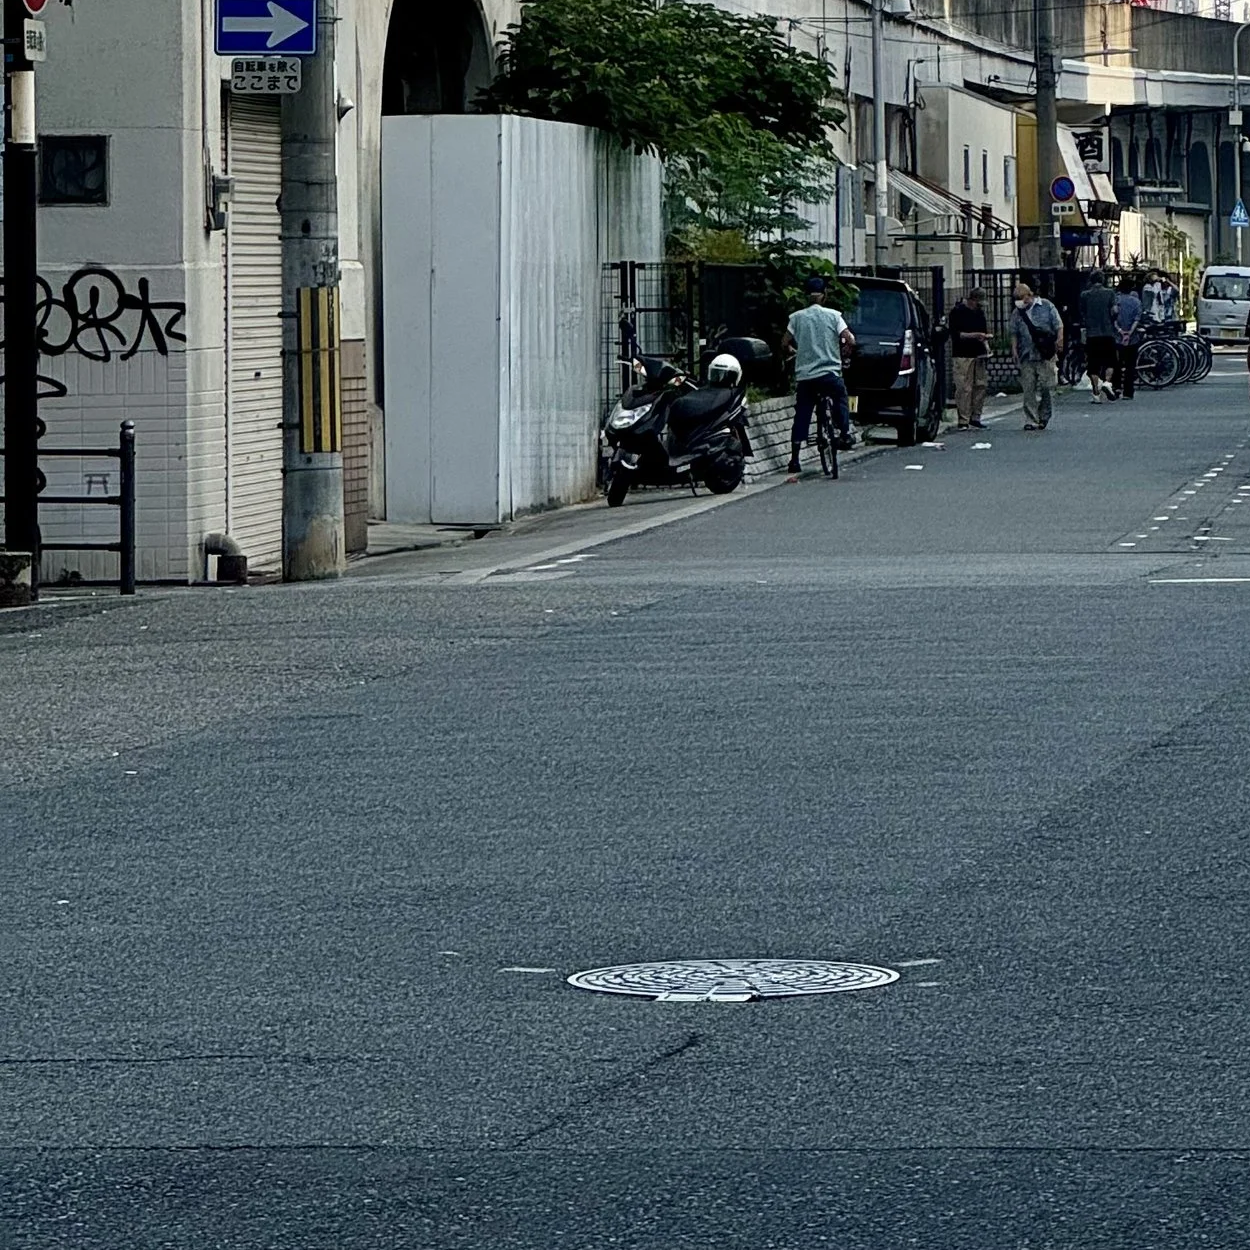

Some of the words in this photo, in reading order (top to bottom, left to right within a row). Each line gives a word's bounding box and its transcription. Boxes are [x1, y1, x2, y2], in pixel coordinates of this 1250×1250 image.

[234, 61, 297, 73] 自転車を除く
[233, 75, 298, 91] ここまで
